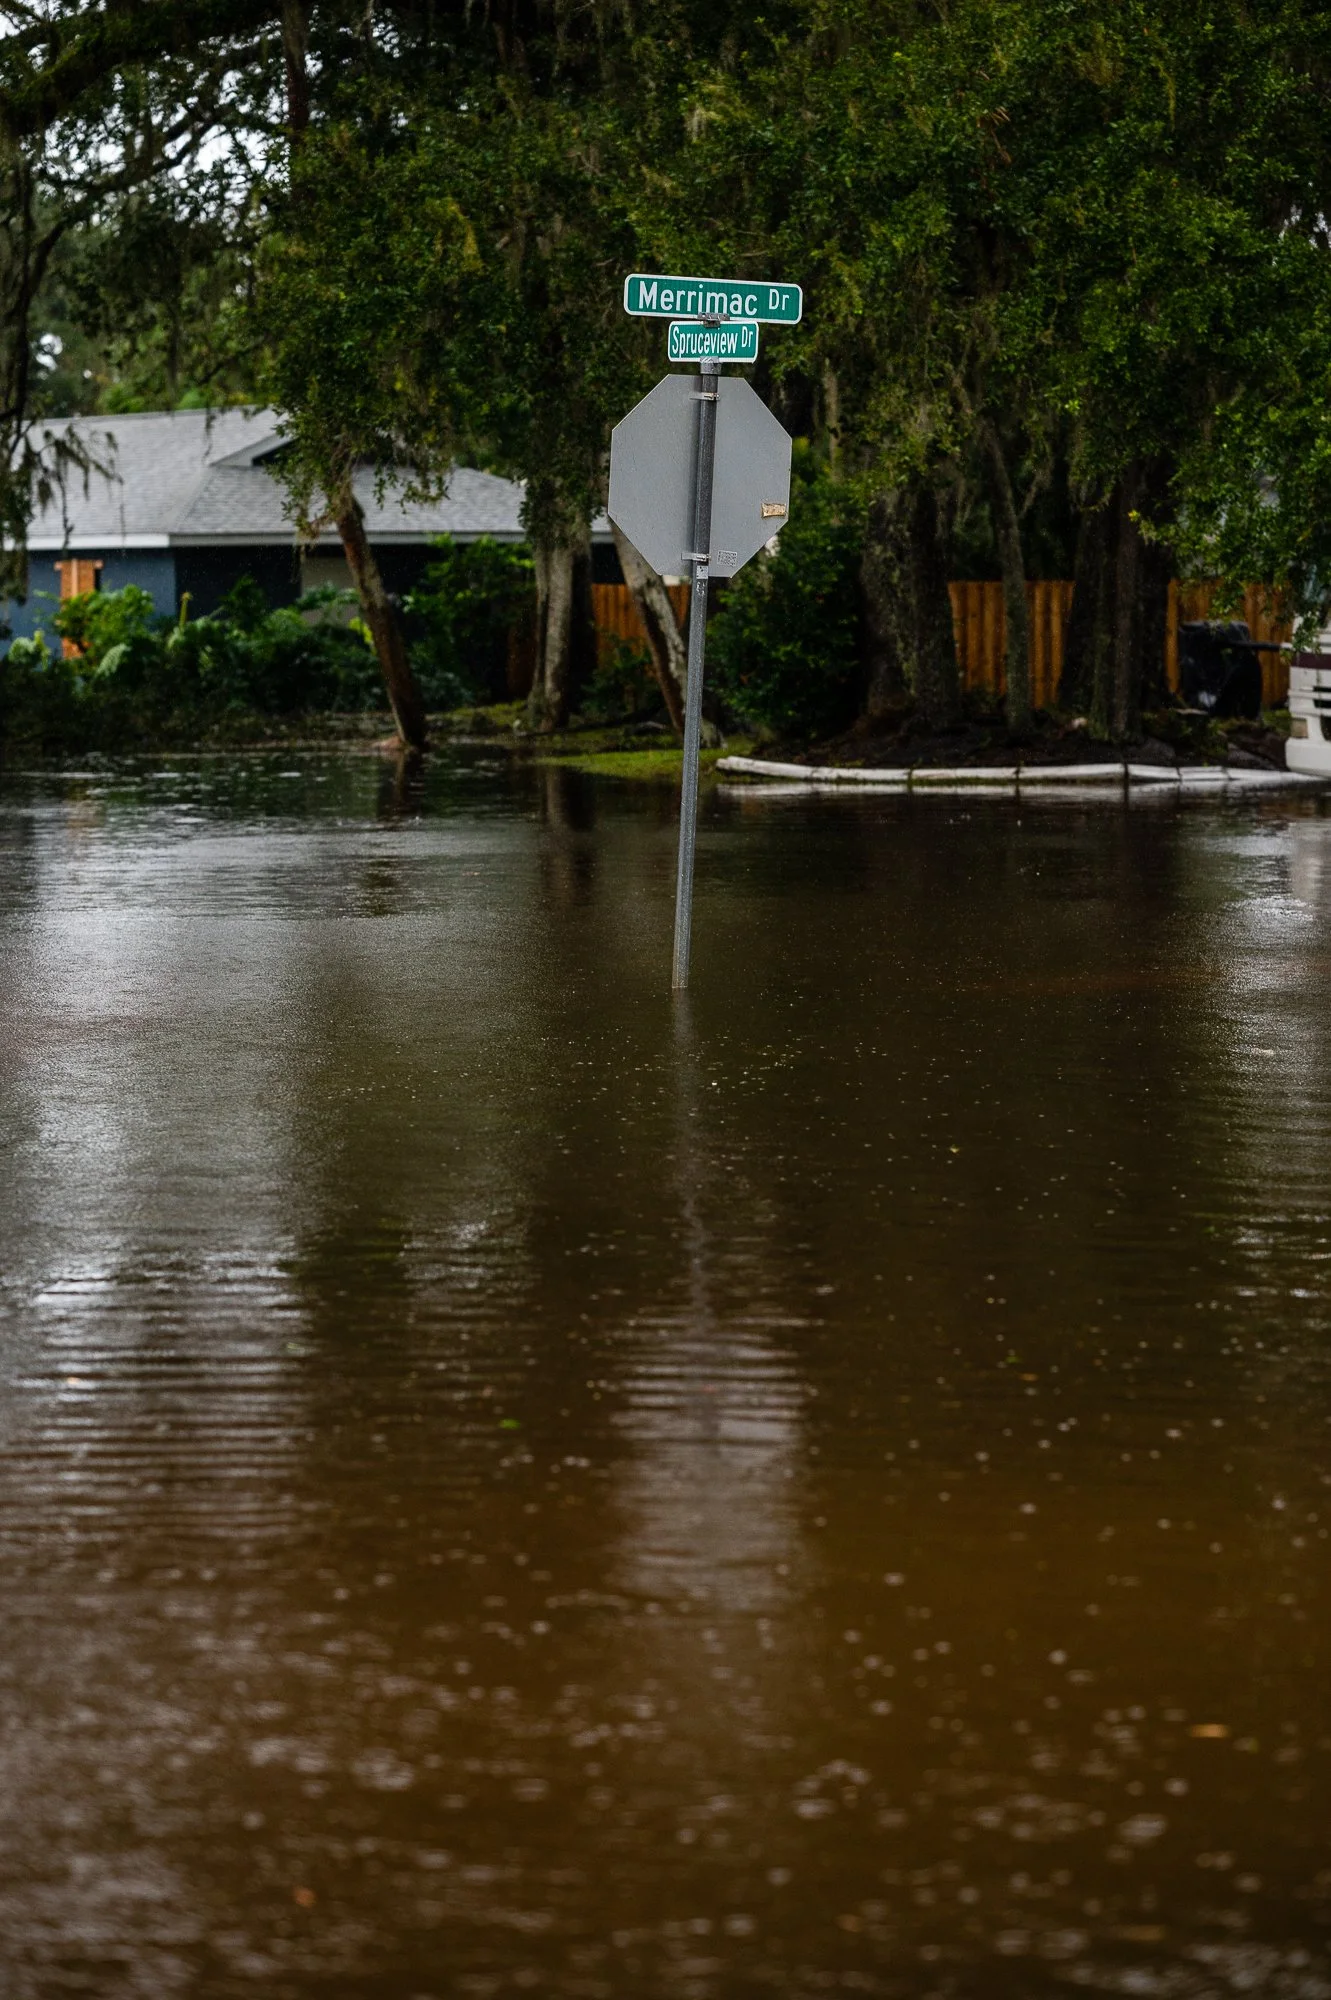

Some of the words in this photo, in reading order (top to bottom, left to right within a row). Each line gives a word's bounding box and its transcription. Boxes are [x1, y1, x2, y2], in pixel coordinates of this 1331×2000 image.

[638, 280, 758, 316] Merrimac
[768, 288, 790, 311] Dr
[671, 326, 738, 358] Spruceview
[741, 325, 754, 348] Dr
